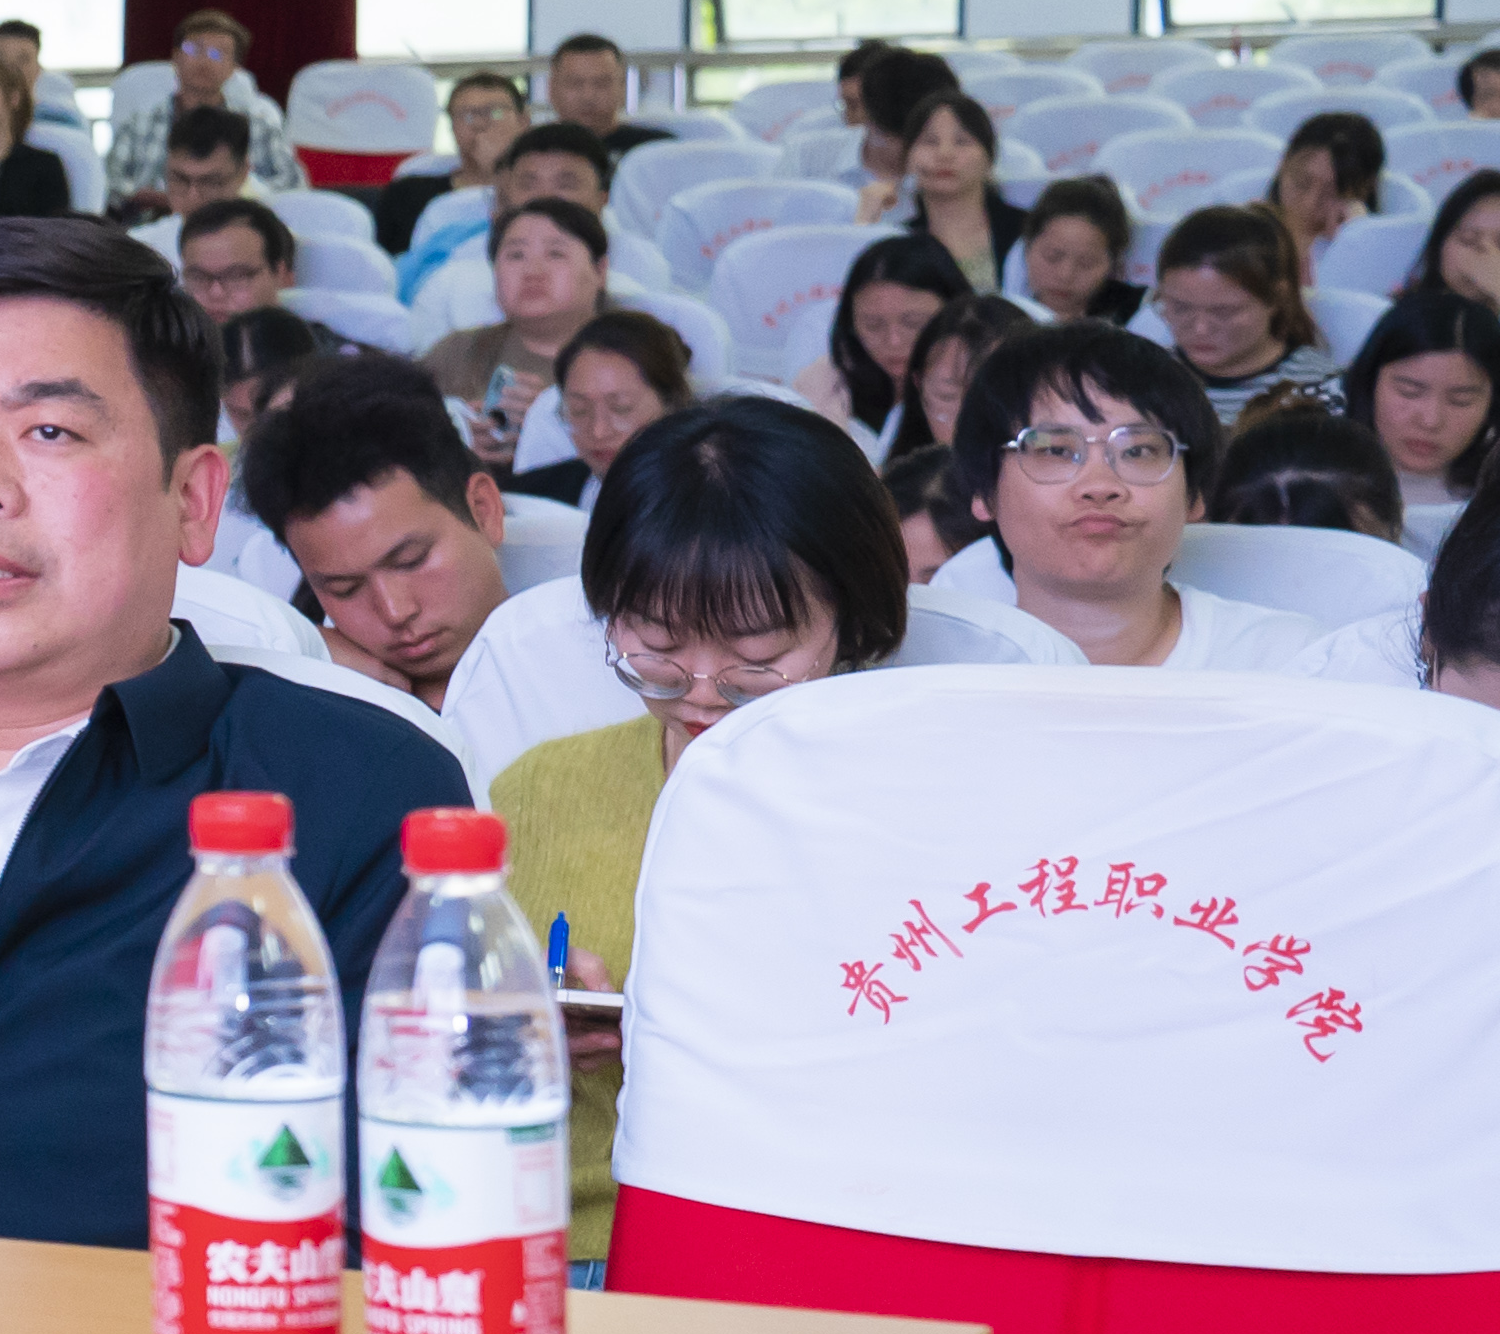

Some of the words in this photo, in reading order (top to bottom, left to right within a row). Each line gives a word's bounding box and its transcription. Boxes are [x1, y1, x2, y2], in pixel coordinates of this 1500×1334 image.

[840, 855, 1363, 1063] 贵州工程职业学院
